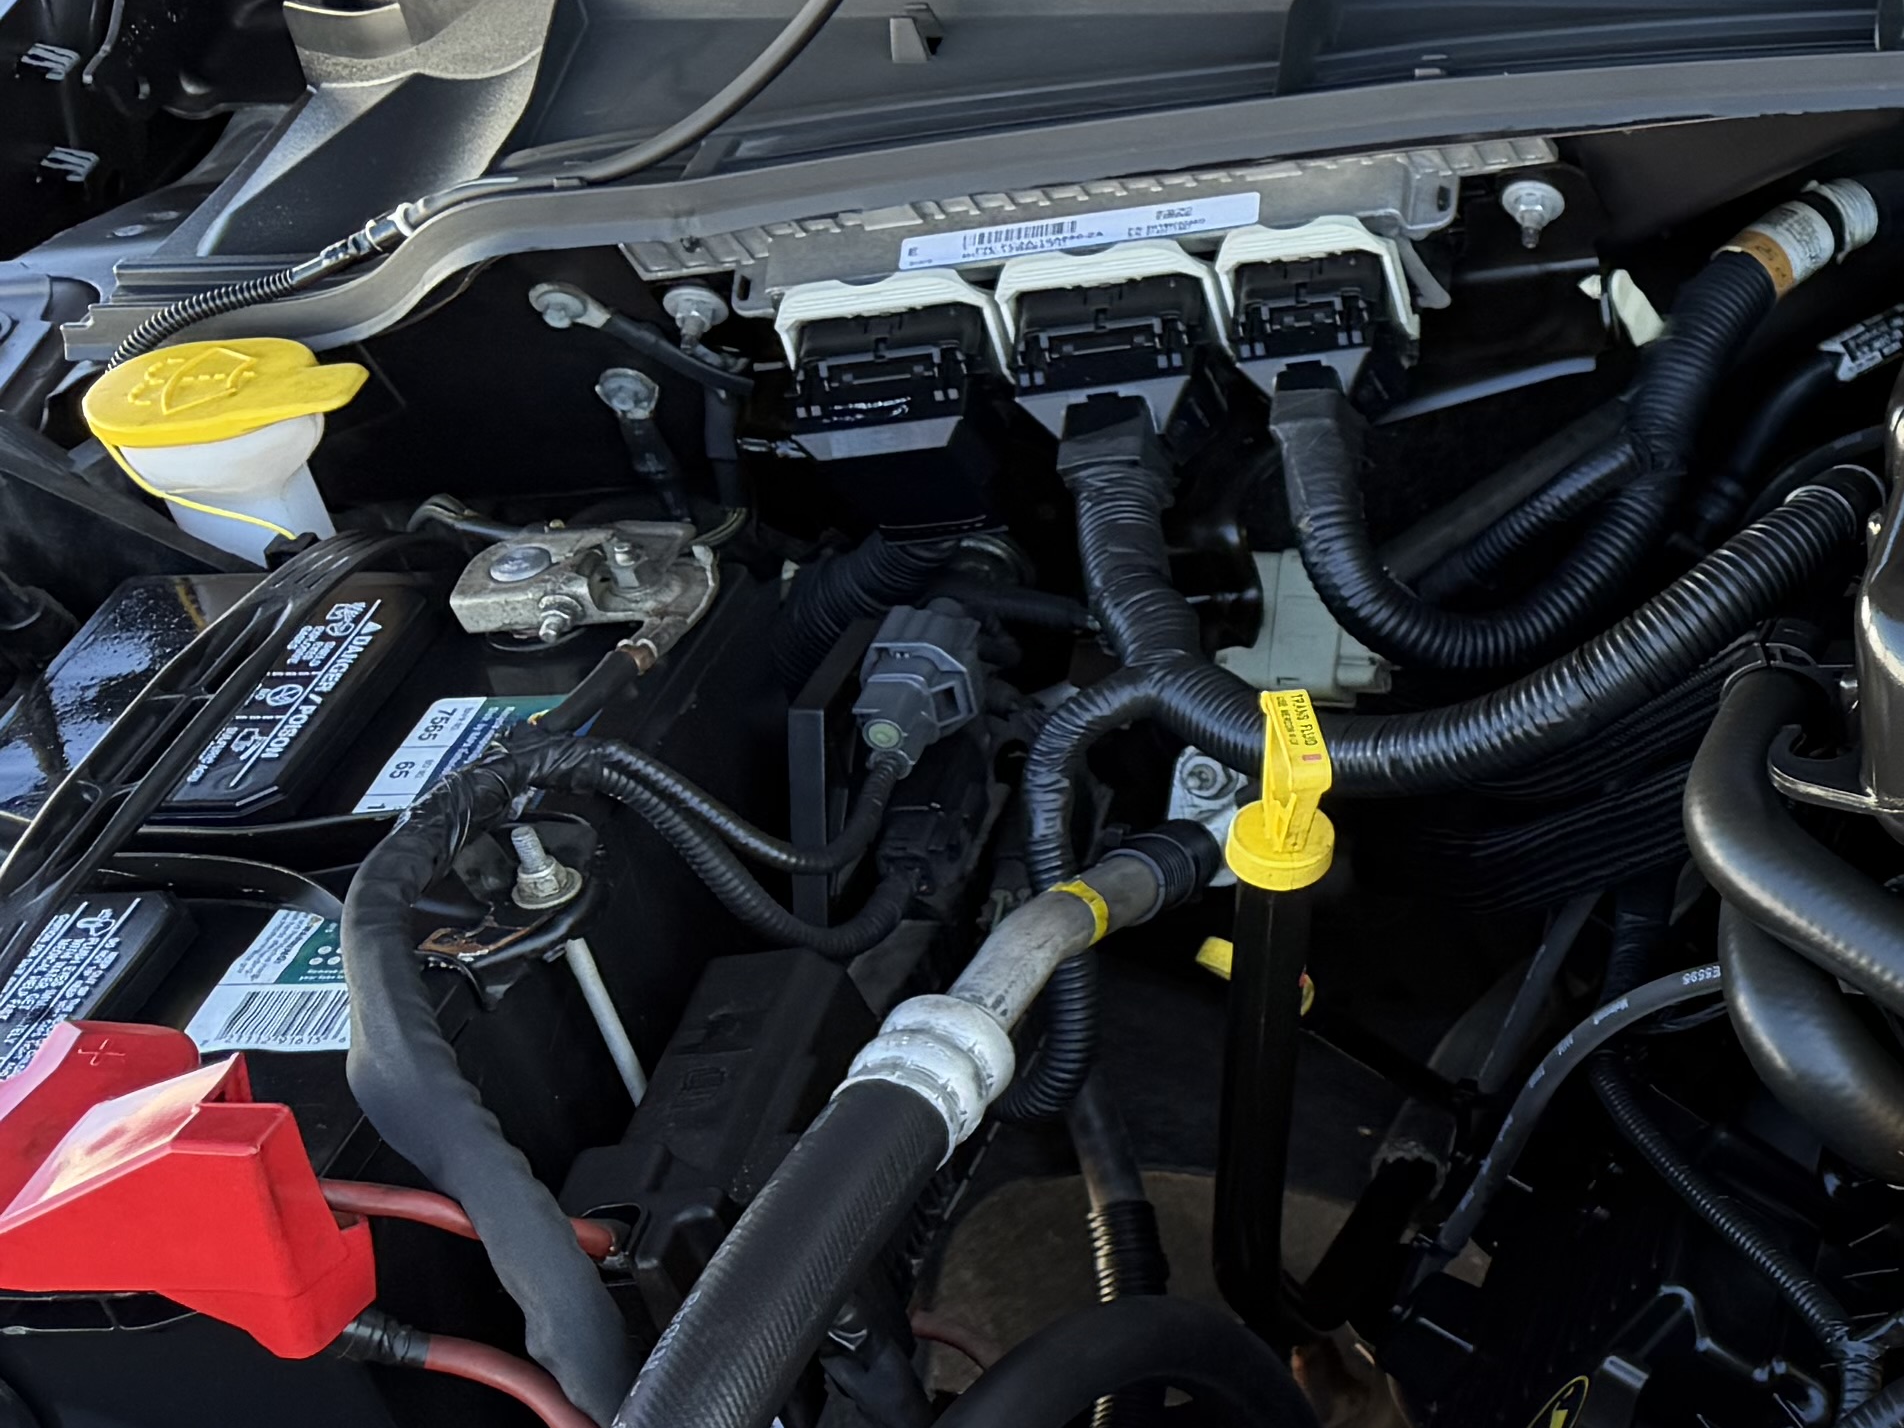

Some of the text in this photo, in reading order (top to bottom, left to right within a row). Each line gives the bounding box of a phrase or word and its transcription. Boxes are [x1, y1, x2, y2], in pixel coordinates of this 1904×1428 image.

[315, 636, 373, 692] DANGER
[417, 707, 459, 741] 7565
[1291, 693, 1310, 721] TRANS
[260, 705, 318, 759] POISON
[389, 760, 416, 780] 65
